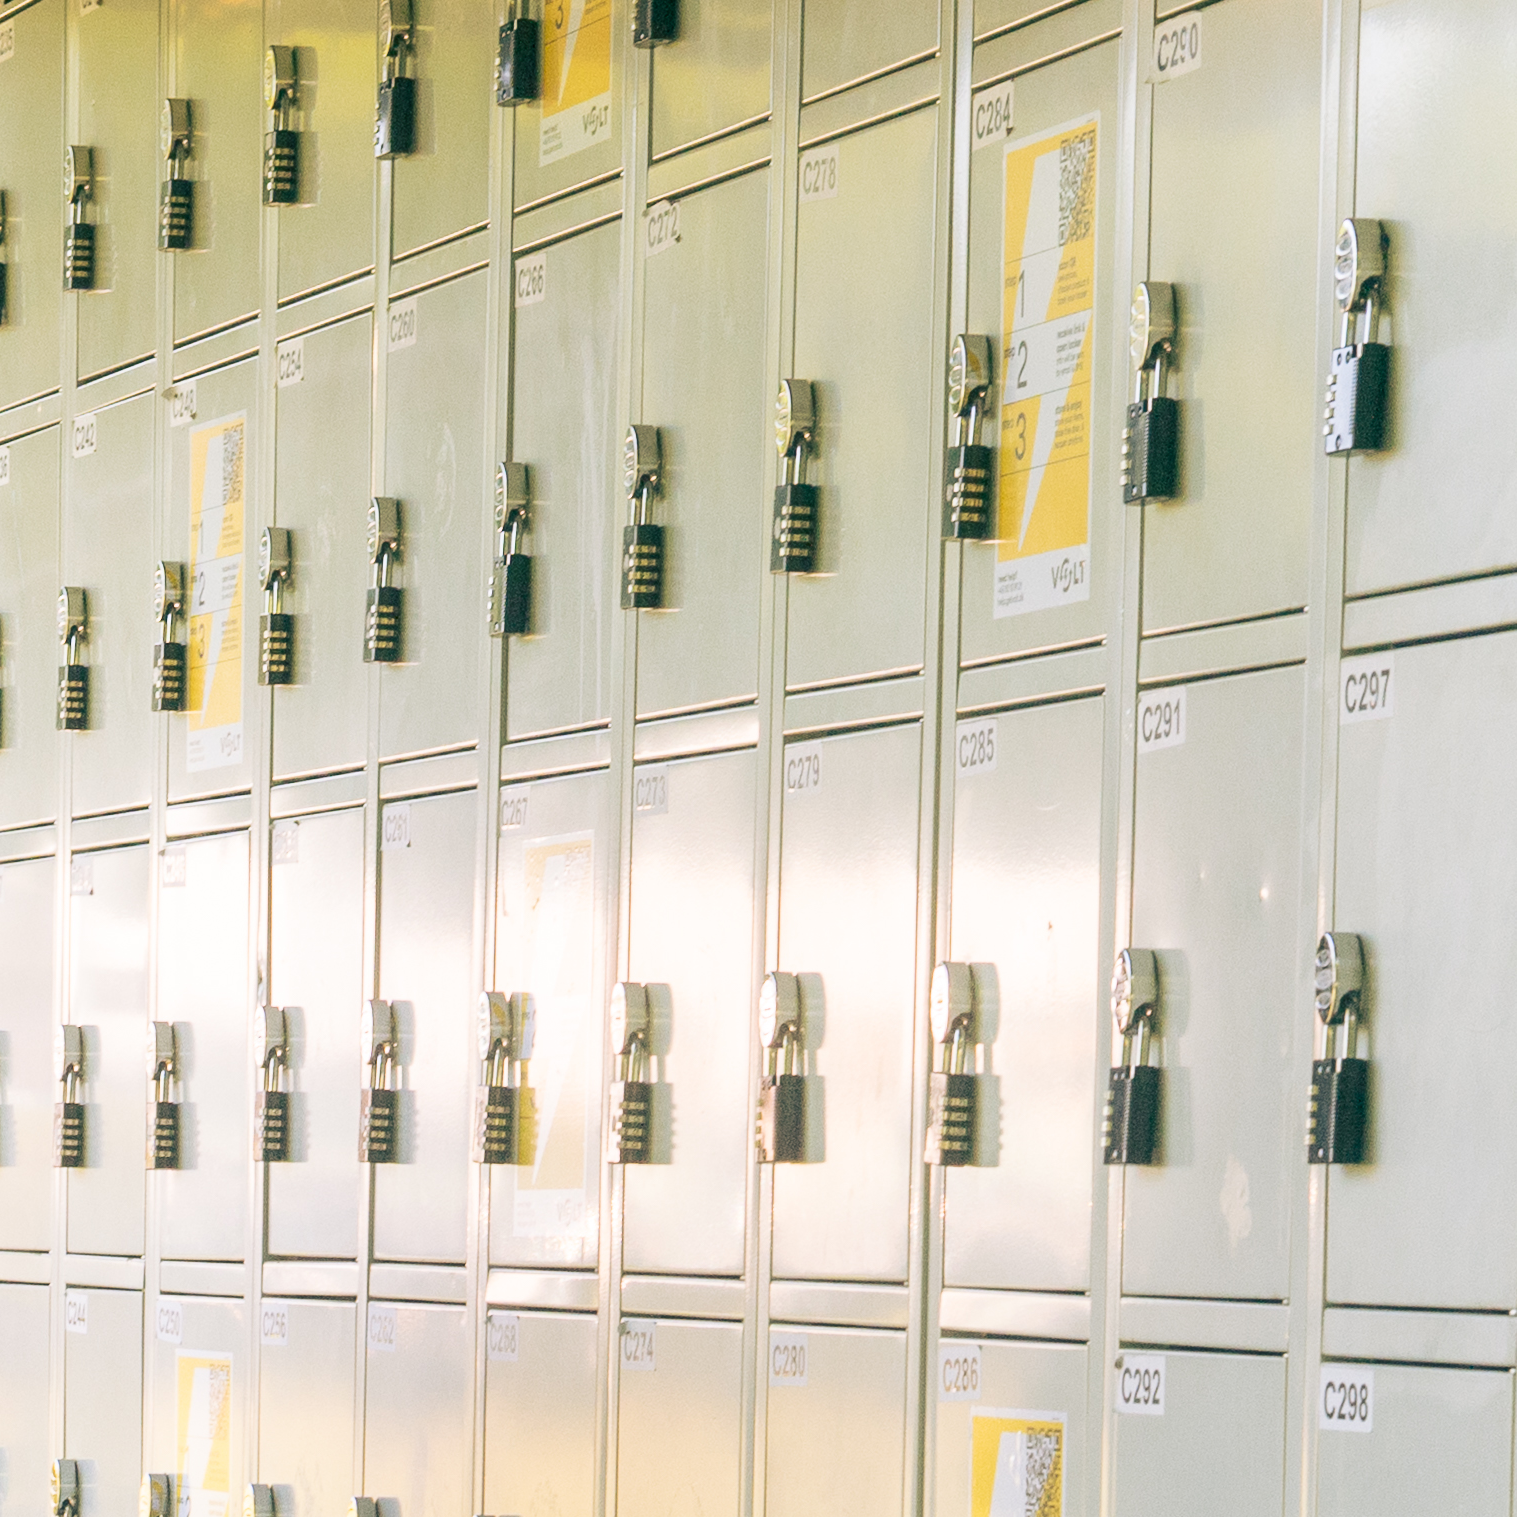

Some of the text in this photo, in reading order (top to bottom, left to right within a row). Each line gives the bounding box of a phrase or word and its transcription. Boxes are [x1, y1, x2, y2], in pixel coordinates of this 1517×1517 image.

[582, 105, 609, 136] VOLT
[976, 92, 1011, 139] C284
[803, 157, 835, 194] C278
[648, 206, 677, 247] C272
[519, 265, 543, 297] C266
[391, 309, 413, 342] C260
[280, 350, 301, 380] C254
[1017, 340, 1028, 389] 2
[174, 389, 193, 418] C248
[76, 423, 94, 451] C242
[1015, 412, 1027, 461] 3
[198, 571, 206, 606] 2
[1051, 557, 1086, 592] VOLT
[198, 623, 206, 659] 3
[1345, 668, 1390, 713] C297
[1143, 698, 1181, 742] C291
[959, 727, 994, 768] C285
[788, 753, 820, 789] C279
[637, 774, 665, 806] C273
[385, 812, 409, 843] C261
[503, 796, 528, 826] C267
[68, 1300, 85, 1325] C244
[159, 1307, 181, 1336] C250
[264, 1311, 286, 1338] C256
[491, 1323, 516, 1354] C268
[624, 1331, 654, 1361] C274
[773, 1344, 804, 1378] C280
[942, 1356, 977, 1393] C286
[1122, 1367, 1160, 1405] C292
[1324, 1381, 1369, 1422] C298
